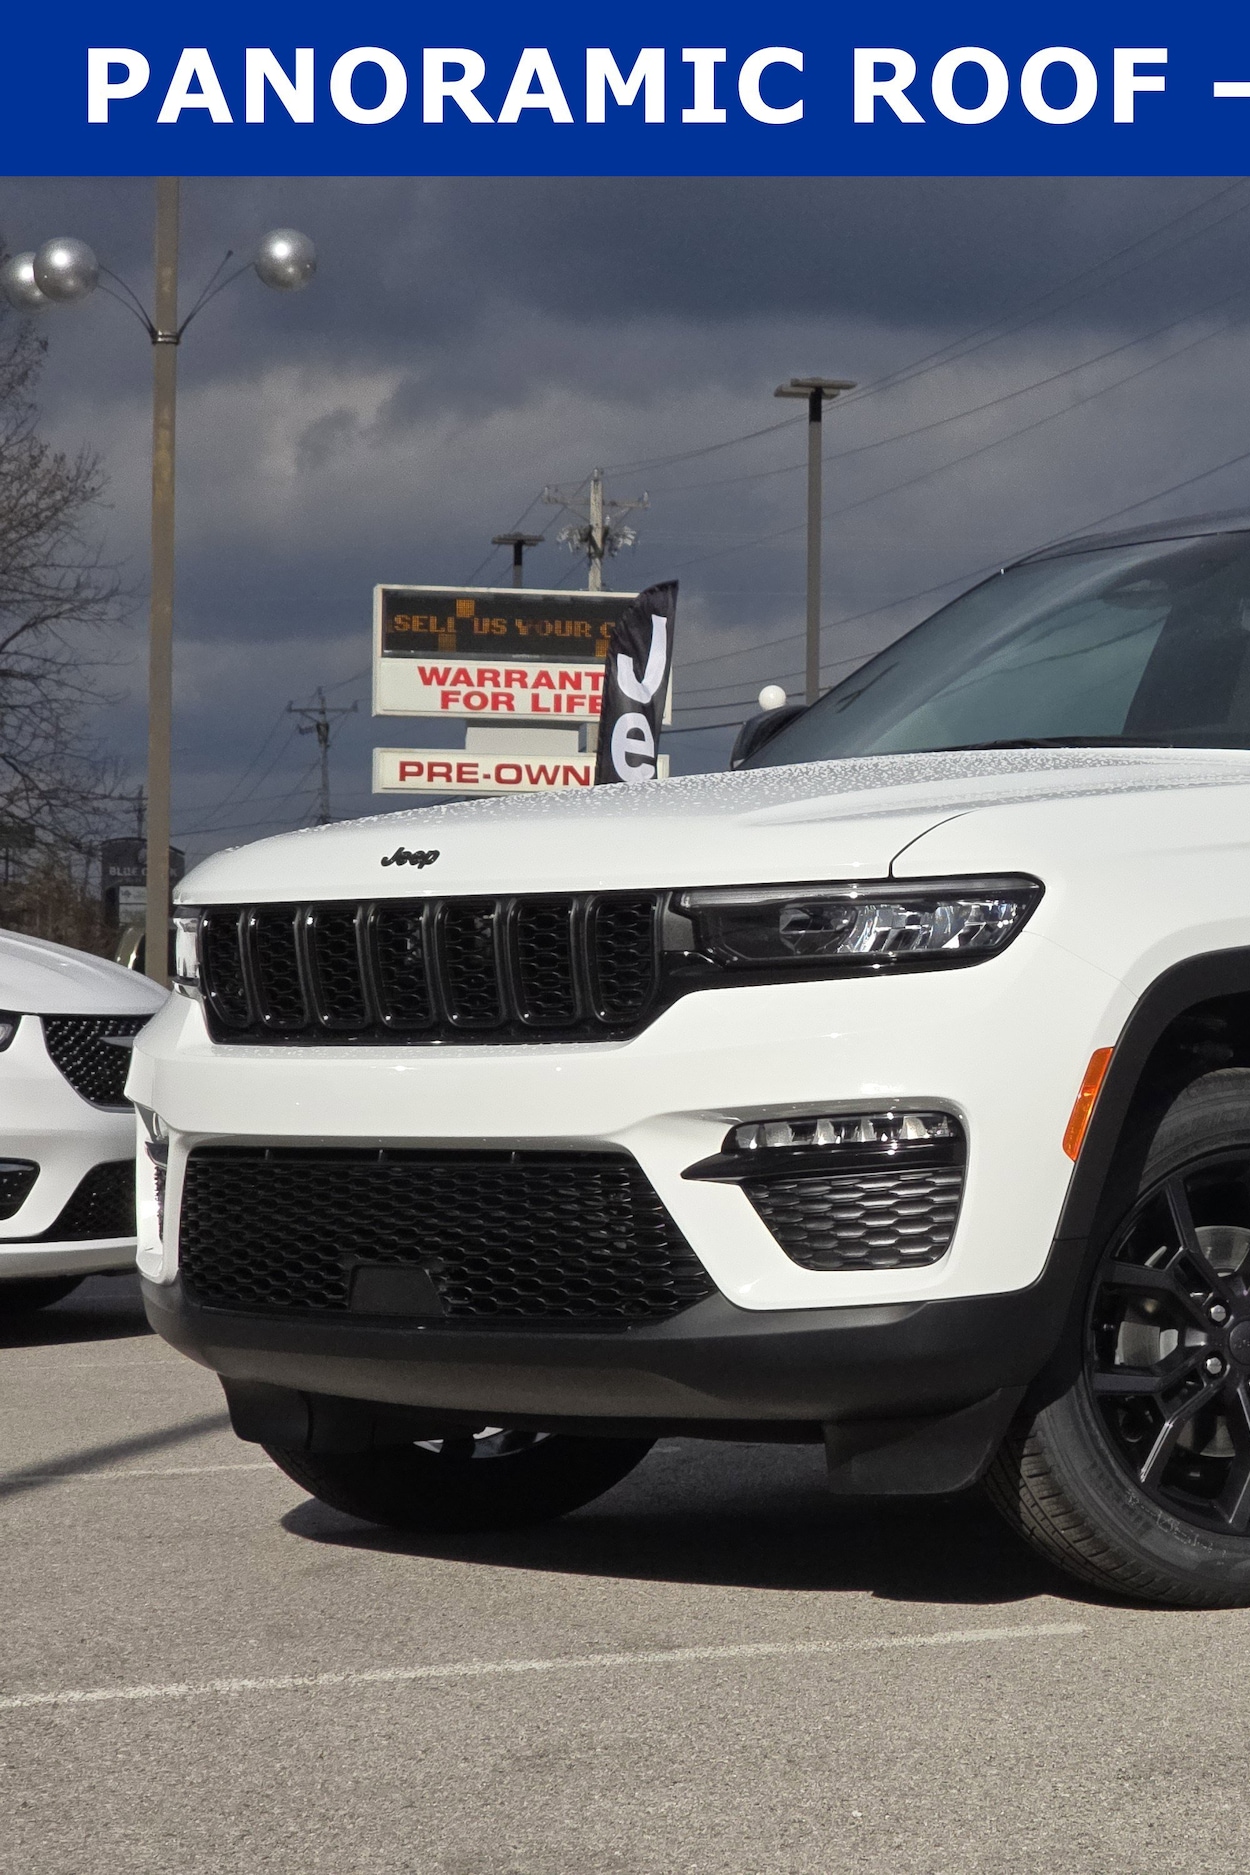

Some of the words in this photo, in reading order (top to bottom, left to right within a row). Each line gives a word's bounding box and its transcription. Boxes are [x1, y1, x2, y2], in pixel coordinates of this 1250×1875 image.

[394, 614, 457, 633] SELL
[473, 617, 508, 635] US
[417, 666, 605, 691] WARRANT
[440, 690, 515, 712] FOR
[531, 692, 602, 714] LIFE
[611, 614, 667, 783] Je
[399, 761, 591, 787] PRE-OWN
[381, 846, 440, 869] Jeep
